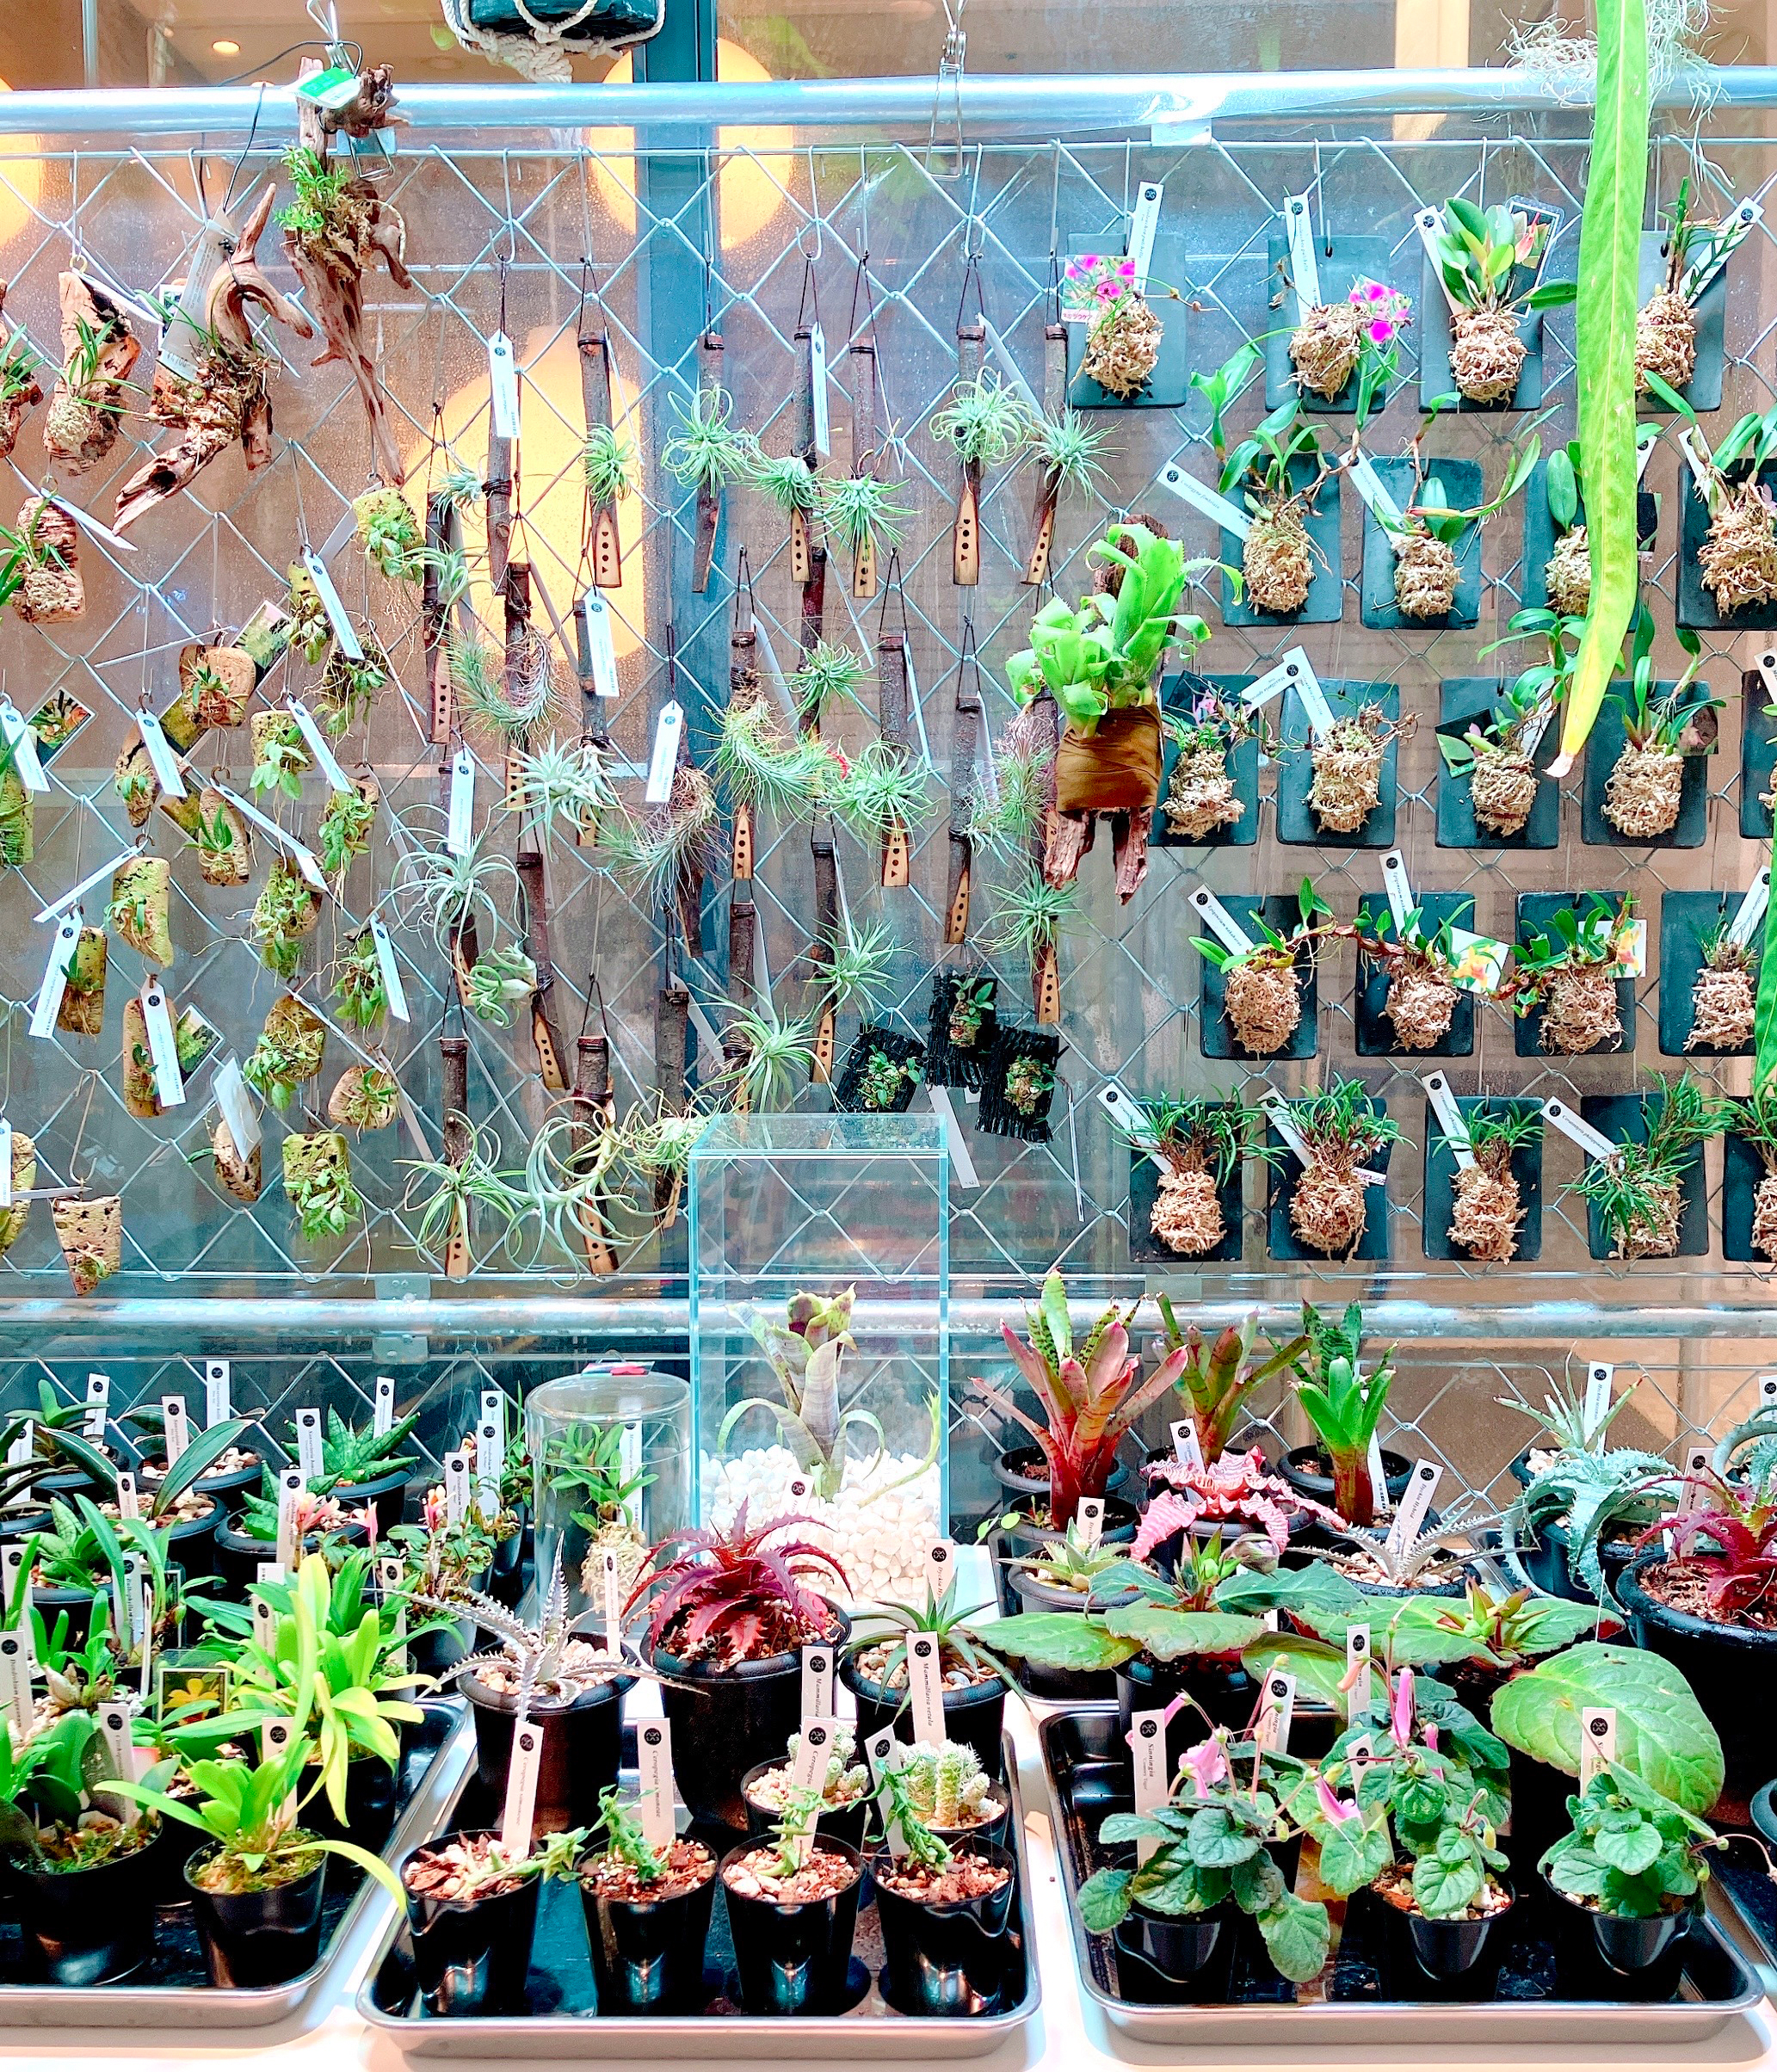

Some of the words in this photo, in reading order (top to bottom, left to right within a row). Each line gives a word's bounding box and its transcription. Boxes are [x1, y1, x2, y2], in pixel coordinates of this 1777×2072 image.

[1595, 1383, 1603, 1402] Hechtia
[1408, 1500, 1421, 1519] Hybrid
[1415, 1483, 1428, 1502] Dyckia
[9, 1658, 19, 1695] Dendrobium
[922, 1662, 932, 1705] Mammillaria
[813, 1677, 822, 1717] Mammillaria
[518, 1756, 529, 1791] Ceropegia
[651, 1749, 659, 1785] Ceropegia
[805, 1749, 819, 1785] Ceropegia
[1146, 1742, 1155, 1777] Sinningia
